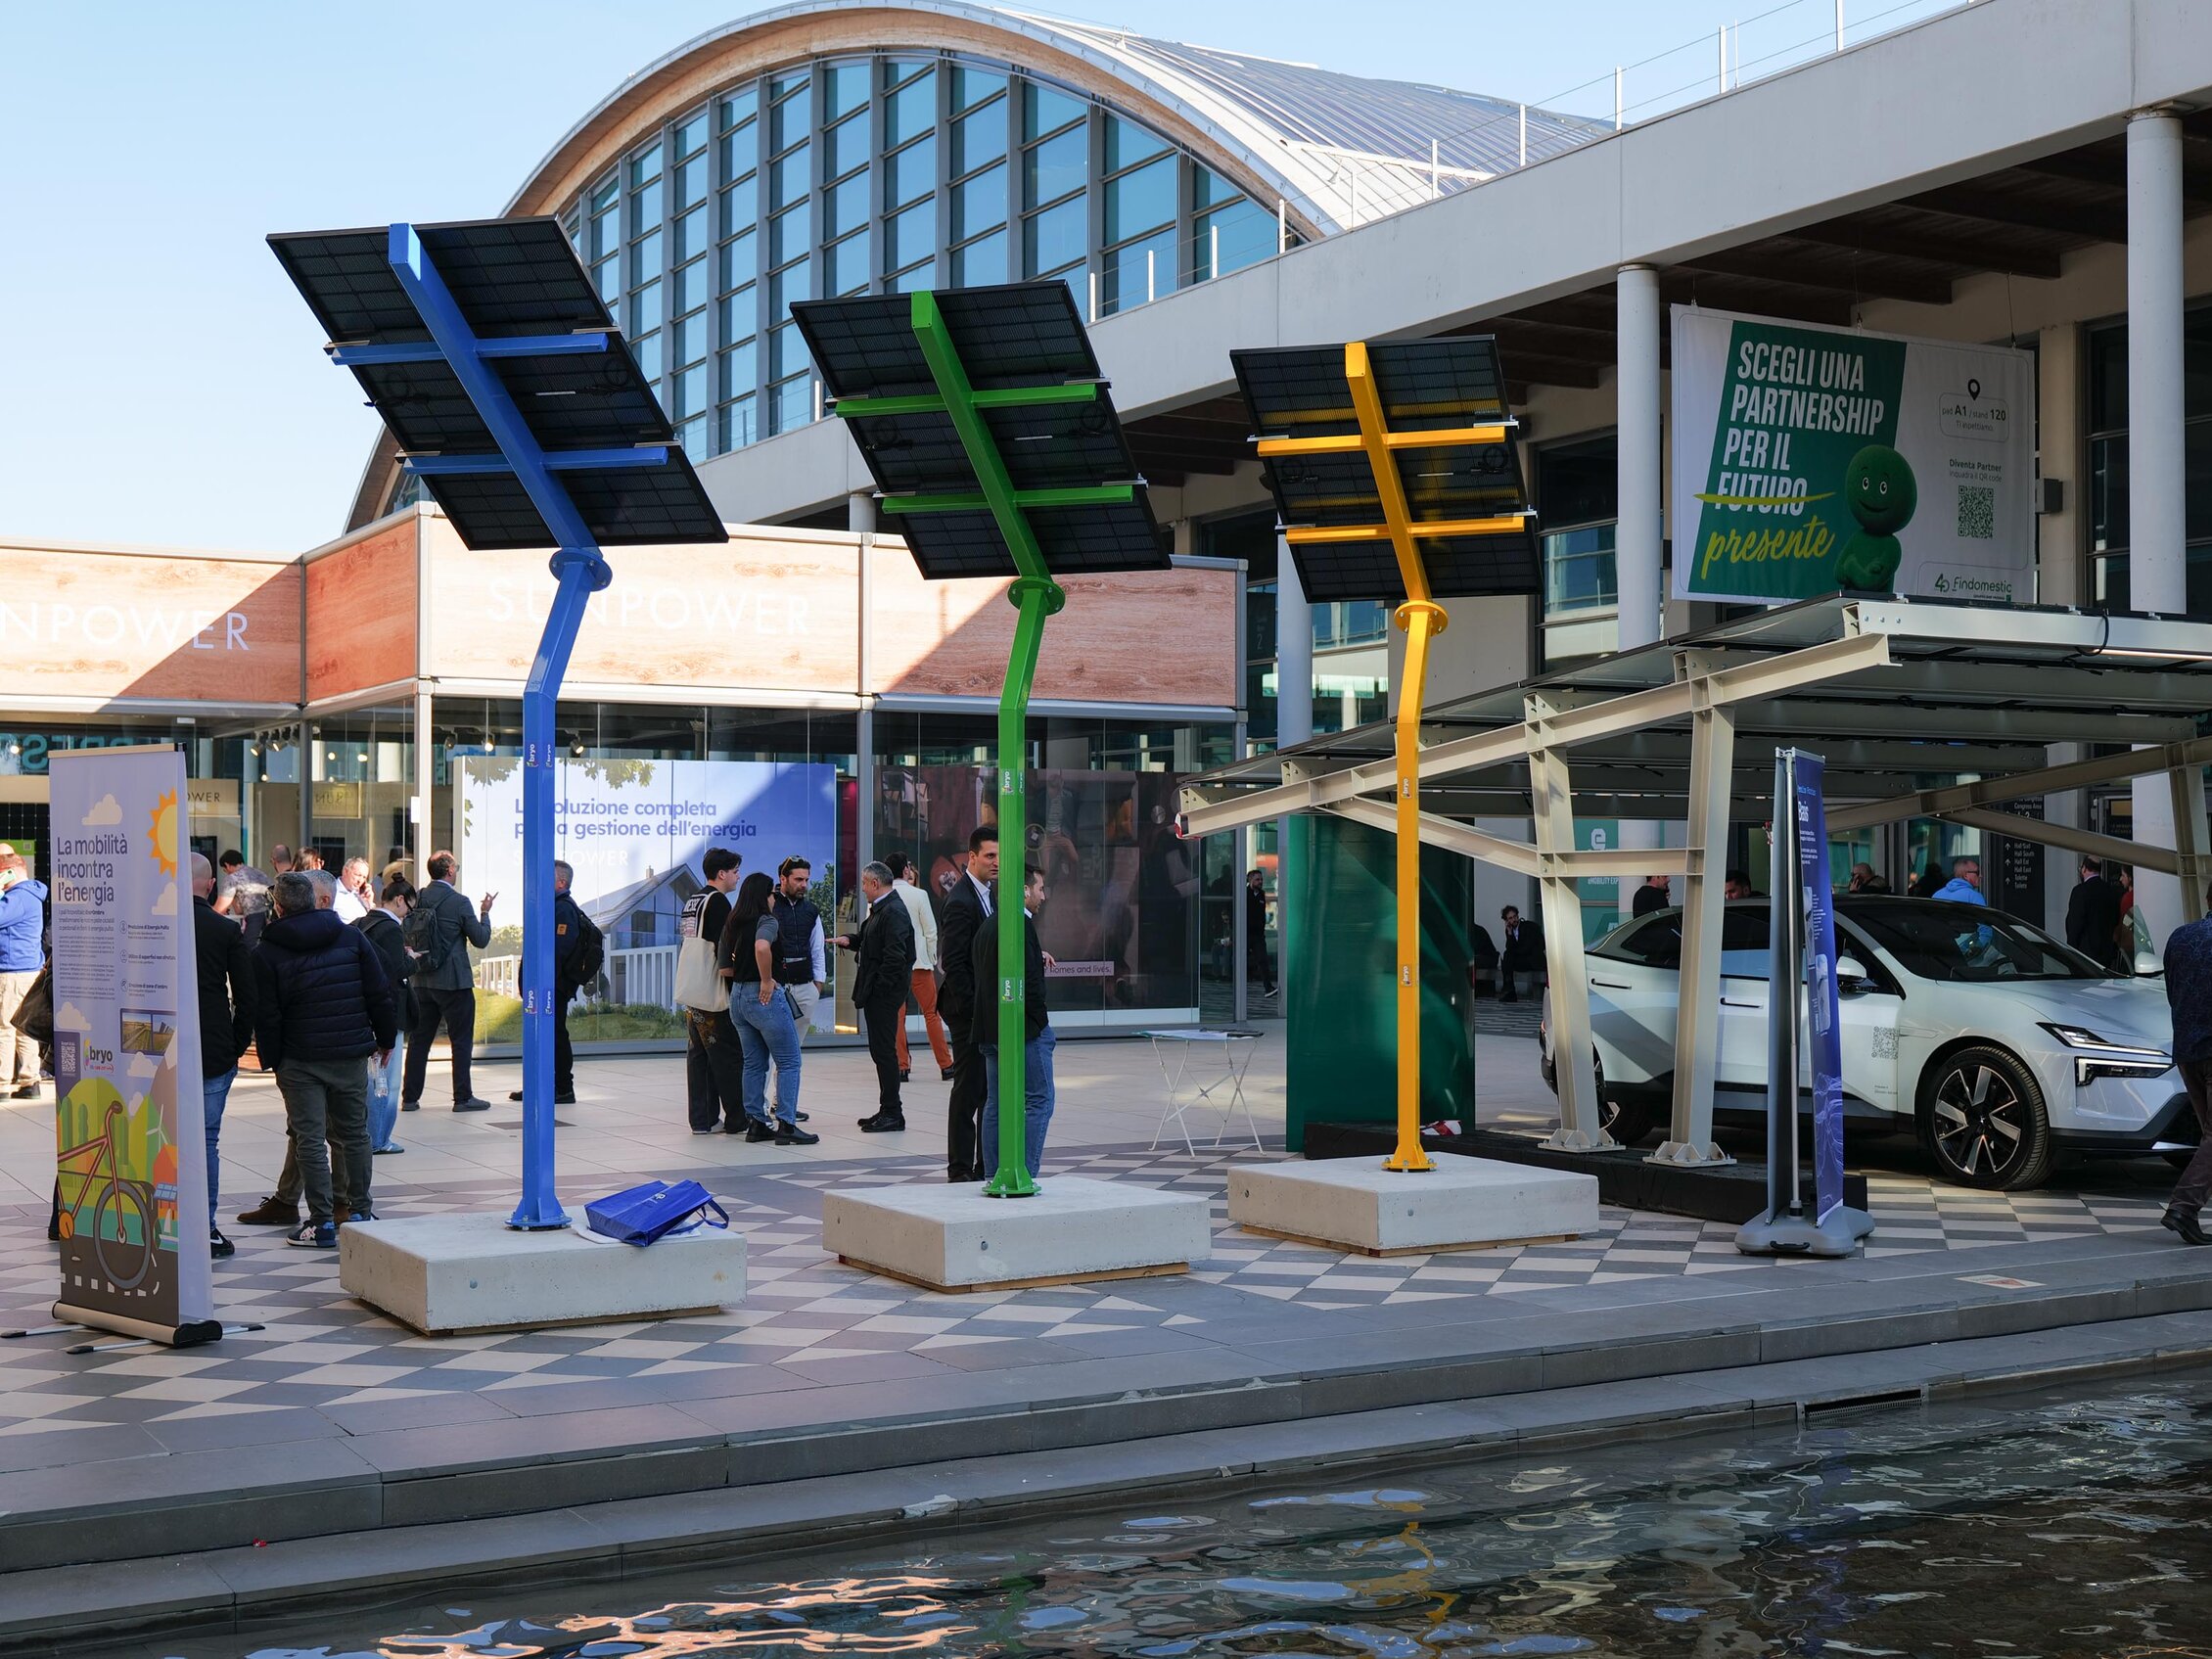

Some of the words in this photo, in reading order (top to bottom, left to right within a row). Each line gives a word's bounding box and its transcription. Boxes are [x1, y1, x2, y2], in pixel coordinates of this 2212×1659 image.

[1737, 341, 1816, 386] SCEGLI
[1820, 350, 1864, 392] UNA
[1729, 384, 1885, 436] PARTNERSHIP
[1955, 404, 1966, 417] A1
[1990, 408, 2006, 421] 120
[1723, 428, 1770, 469] PER
[1772, 432, 1791, 471] IL
[1949, 458, 1975, 470] Diventa
[1977, 461, 2002, 473] Partner
[1715, 471, 1808, 517] FUTURO
[1700, 515, 1836, 580] presente
[554, 797, 629, 815] oluzione
[634, 800, 717, 819] completa
[575, 818, 652, 840] gestione
[656, 820, 758, 841] dell'energia
[57, 837, 72, 855] La
[74, 833, 128, 854] mobilità
[57, 859, 114, 878] incontra
[1077, 965, 1091, 974] and
[1093, 964, 1112, 973] lives.
[89, 1045, 114, 1064] bryo
